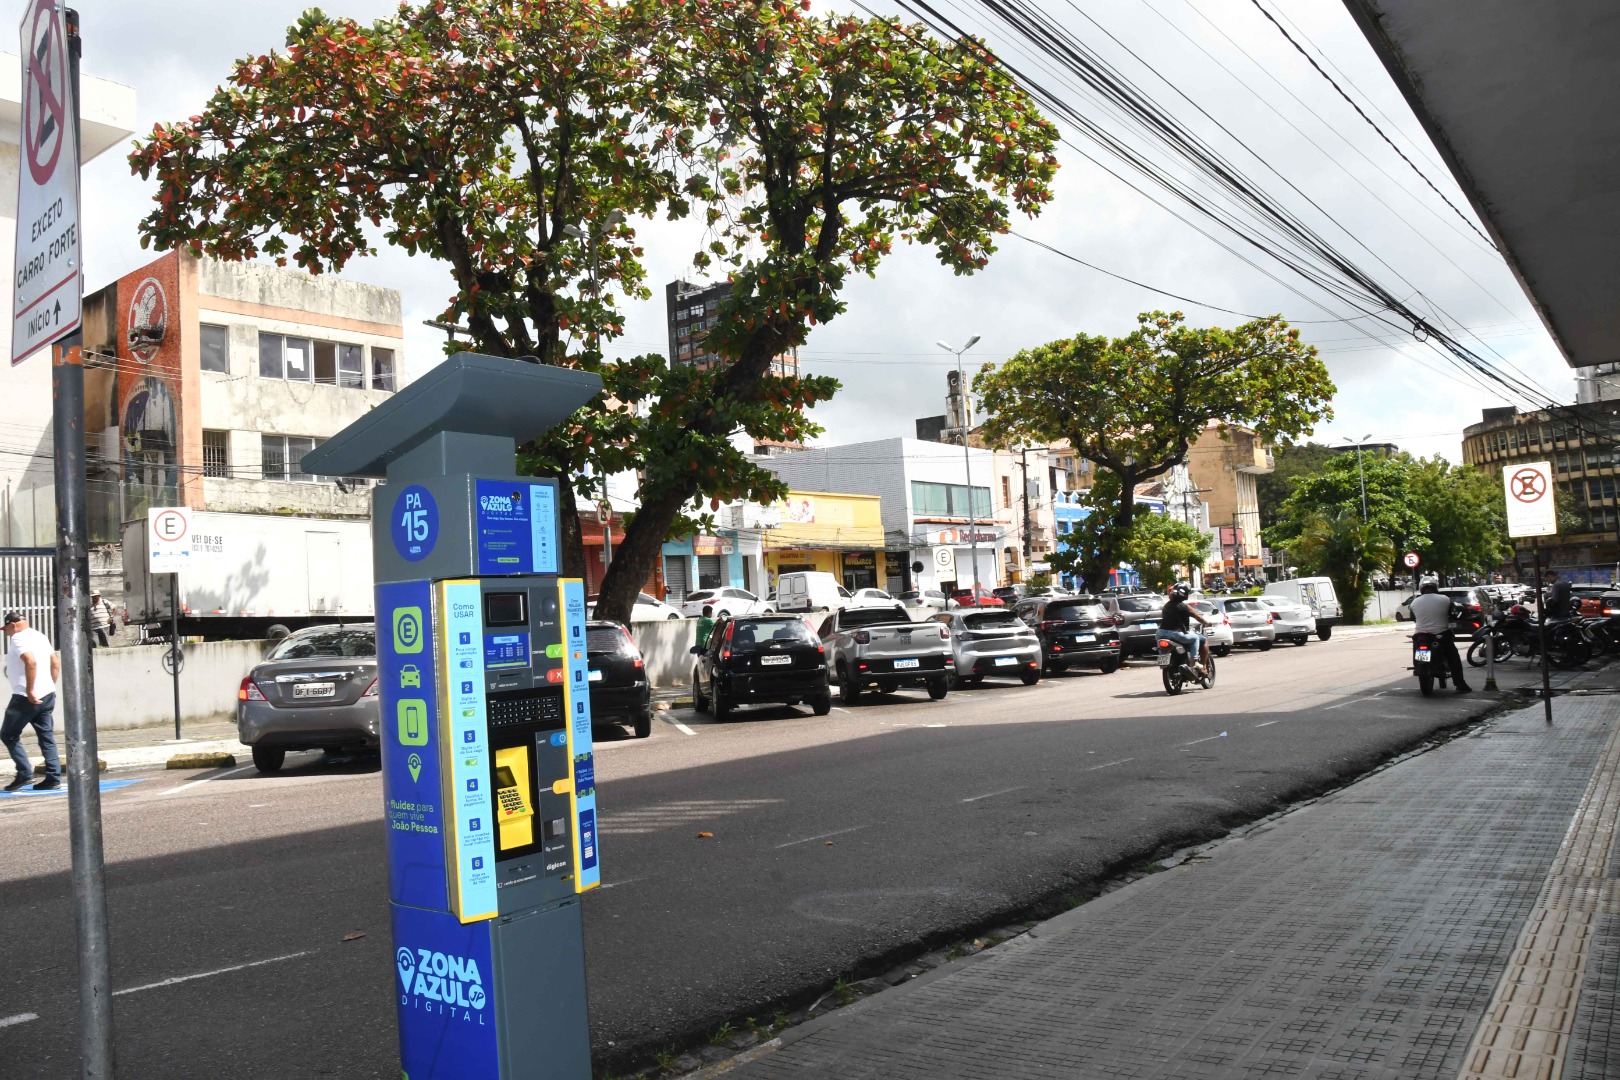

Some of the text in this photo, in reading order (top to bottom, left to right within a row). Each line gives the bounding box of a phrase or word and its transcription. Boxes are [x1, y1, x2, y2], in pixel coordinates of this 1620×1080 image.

[31, 197, 63, 243] EXCETO
[17, 222, 77, 289] CARRO FORTE
[27, 309, 50, 339] INÍCIO
[405, 492, 422, 510] PA
[487, 503, 508, 512] AZUL
[489, 495, 511, 504] ZONA
[165, 517, 176, 535] E
[401, 510, 429, 542] 15
[453, 603, 475, 611] Como
[453, 610, 474, 619] USAR
[403, 621, 412, 639] E
[390, 800, 434, 813] fluidez para
[388, 810, 425, 822] quem vive
[391, 820, 438, 834] João Pessoa
[474, 859, 480, 867] 6
[417, 948, 482, 985] ZONA
[413, 972, 485, 1008] AZUL JP
[401, 994, 485, 1026] DIGITAL
